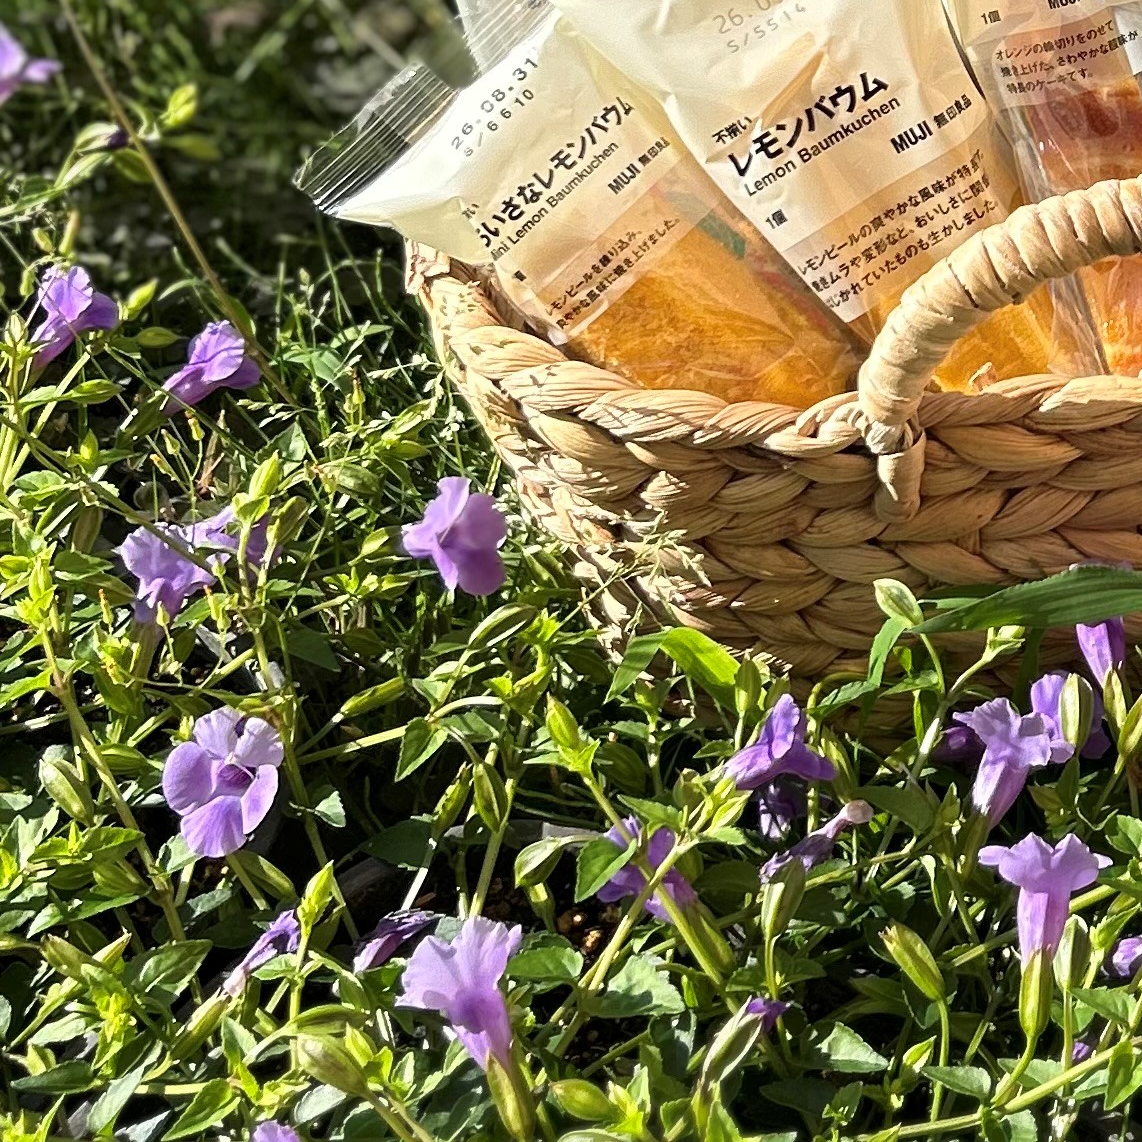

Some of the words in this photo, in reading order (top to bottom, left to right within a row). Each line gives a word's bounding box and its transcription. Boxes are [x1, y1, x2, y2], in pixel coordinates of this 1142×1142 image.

[980, 8, 1002, 25] 1個
[727, 71, 889, 178] レモンバウム
[743, 158, 798, 197] Lemon
[797, 96, 901, 164] Baumkuchen
[889, 120, 933, 155] MUJI
[932, 93, 973, 130] 無印良品
[507, 206, 550, 245] Lemon
[545, 140, 620, 210] Baumkuchen
[607, 162, 642, 196] MUJI
[764, 207, 788, 230] 1個
